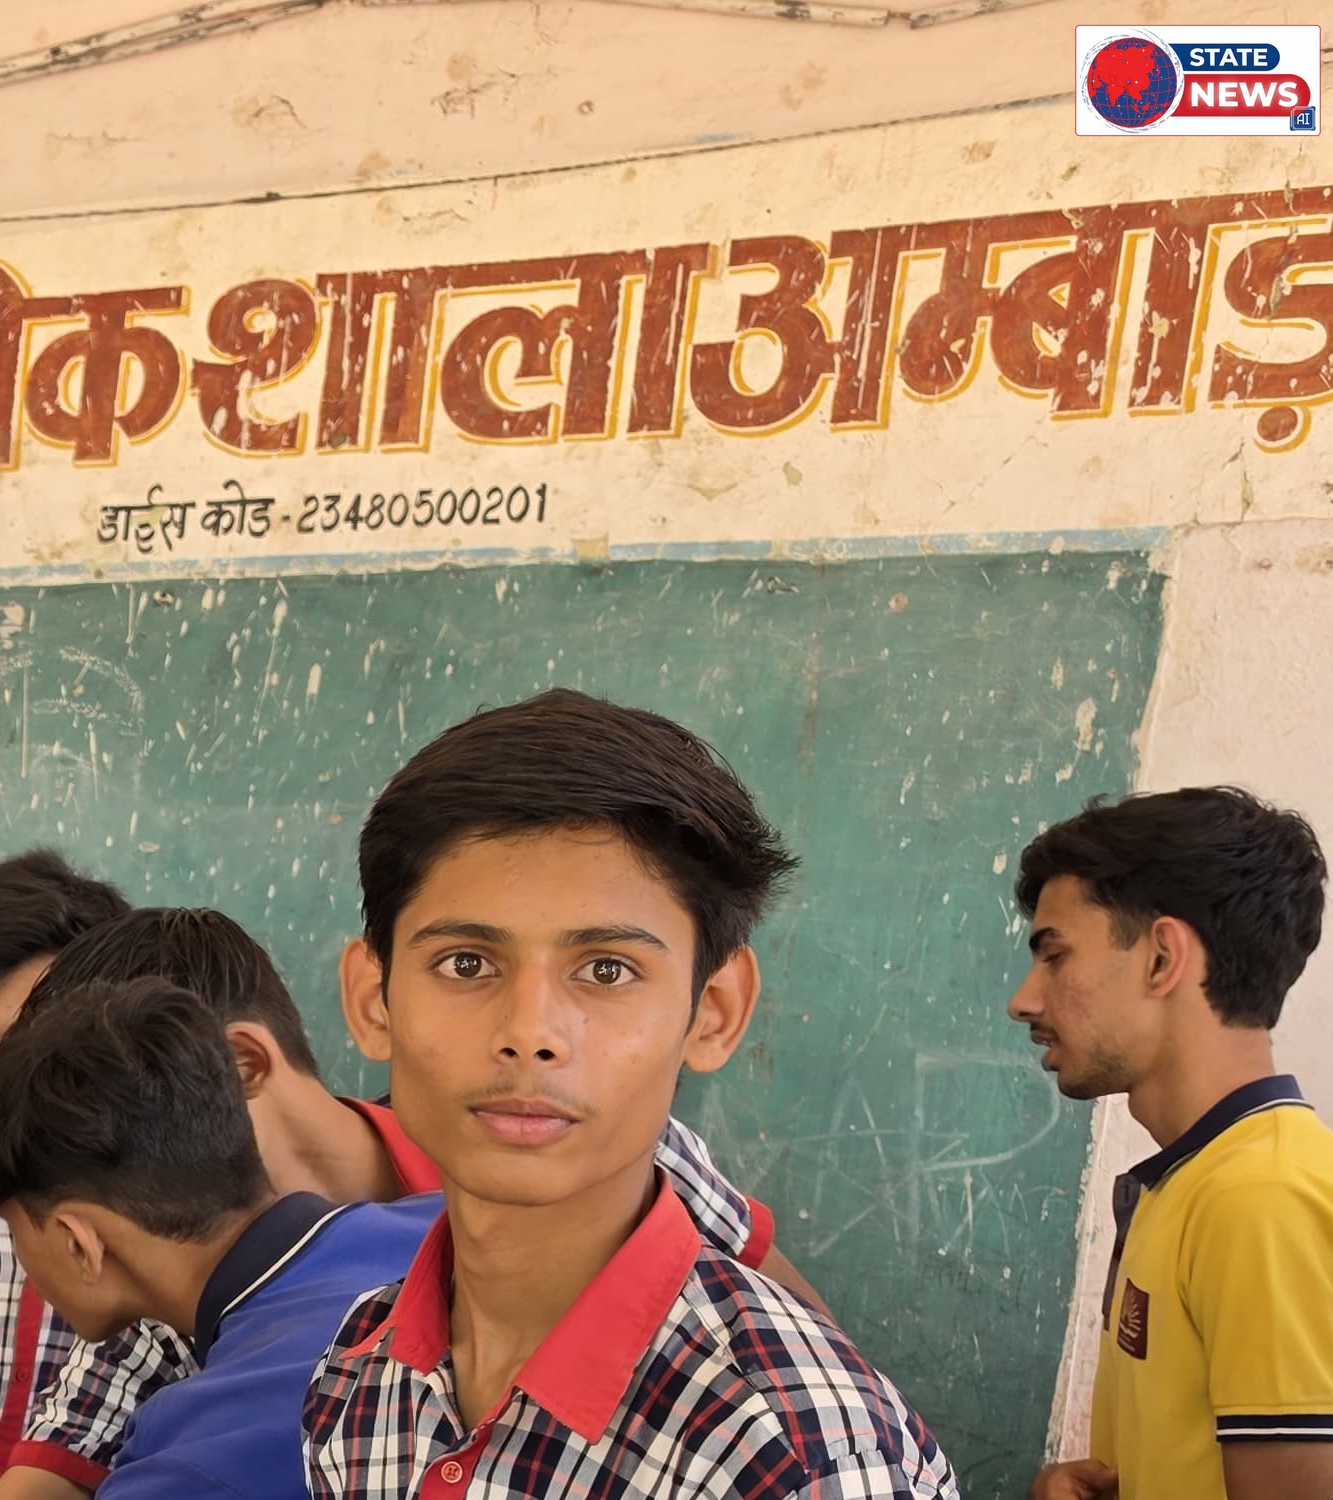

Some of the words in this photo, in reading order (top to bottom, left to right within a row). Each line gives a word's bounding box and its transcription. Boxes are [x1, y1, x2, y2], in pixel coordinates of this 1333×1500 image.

[191, 242, 721, 458] शाला
[201, 479, 276, 538] कोड
[296, 481, 549, 535] 23480500201
